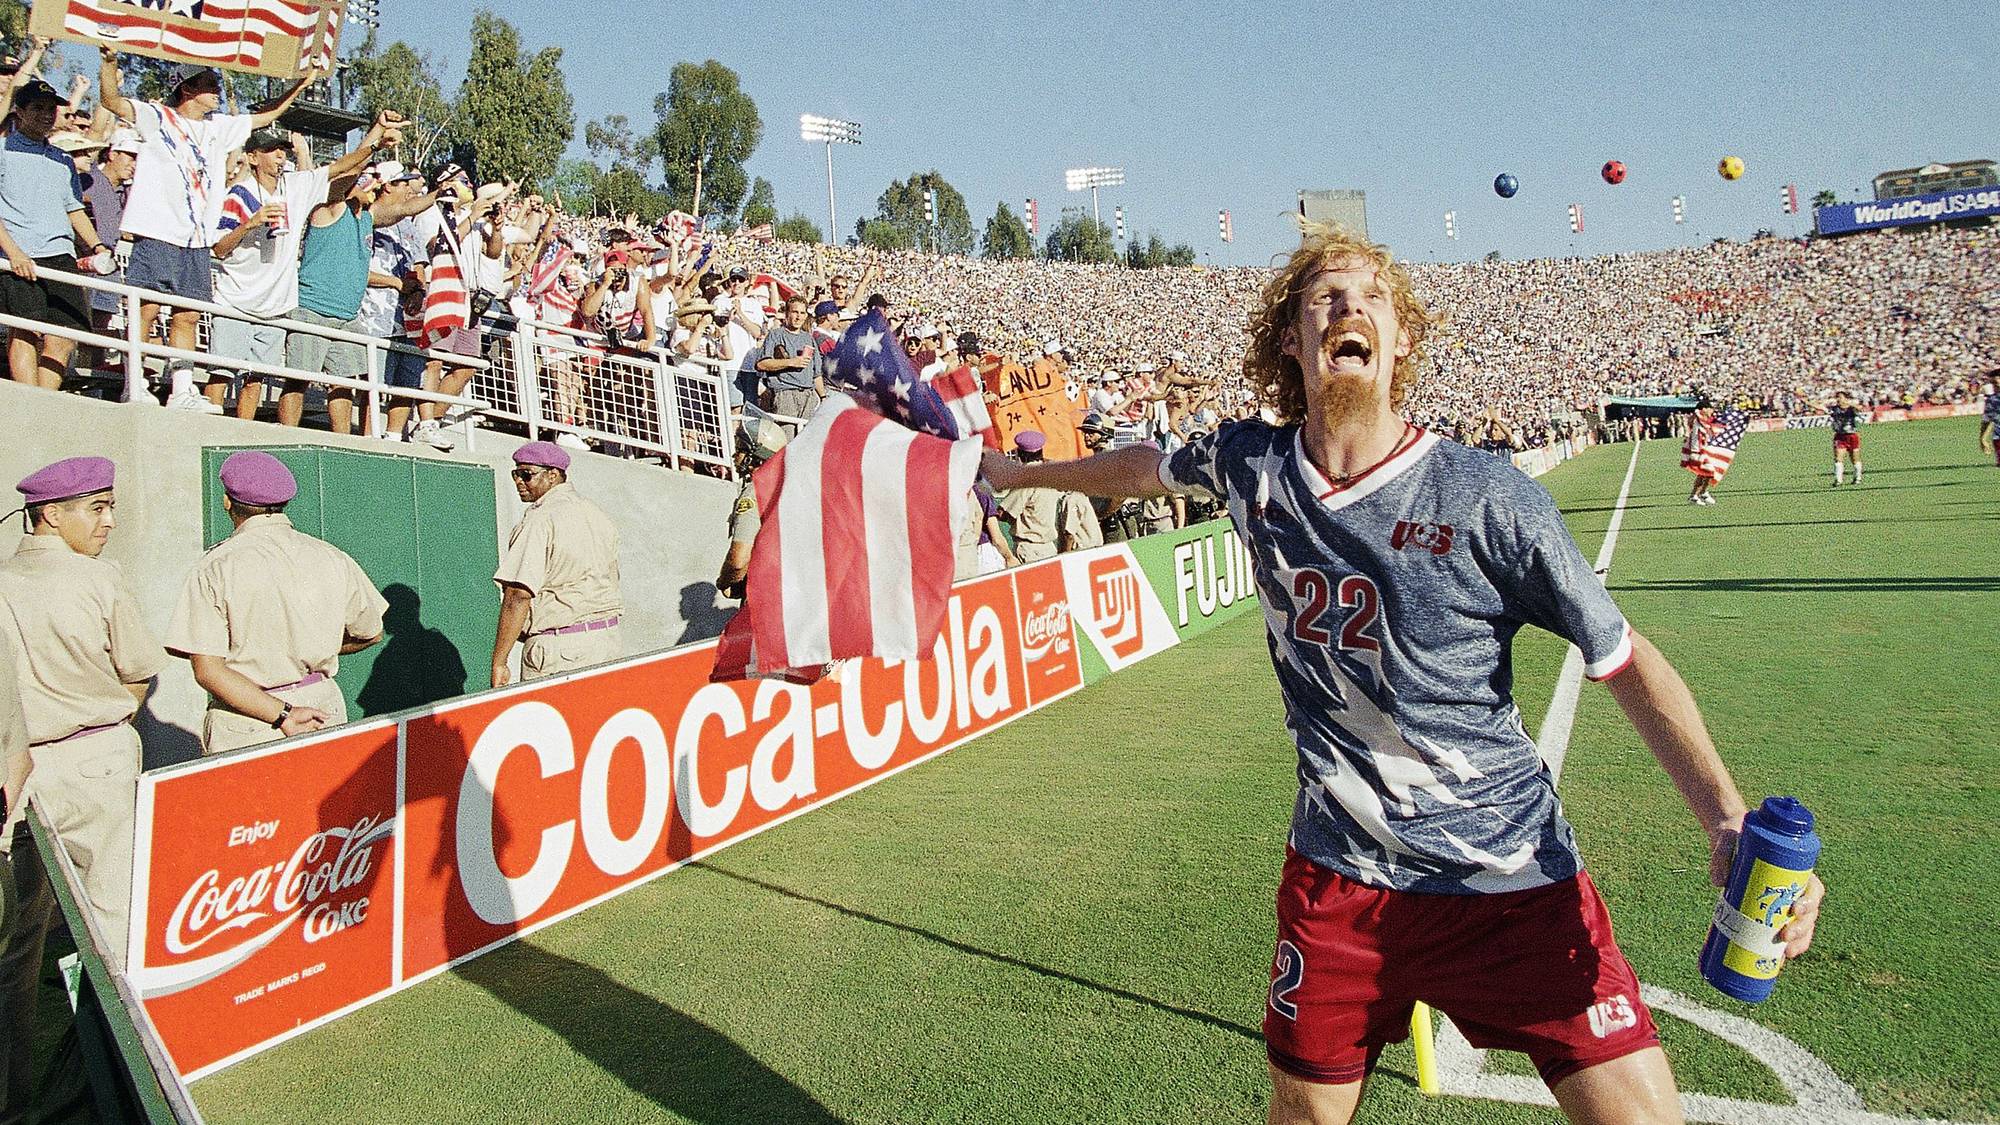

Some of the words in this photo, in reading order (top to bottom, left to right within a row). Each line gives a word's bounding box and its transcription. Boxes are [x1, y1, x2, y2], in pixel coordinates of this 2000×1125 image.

[1294, 567, 1380, 651] 22
[456, 596, 1012, 925] Coca-Cola
[228, 819, 280, 847] Enjoy
[165, 812, 382, 955] Coca-Cola
[303, 897, 370, 943] Coke
[234, 986, 265, 1005] TRADE
[267, 972, 300, 992] MARKS
